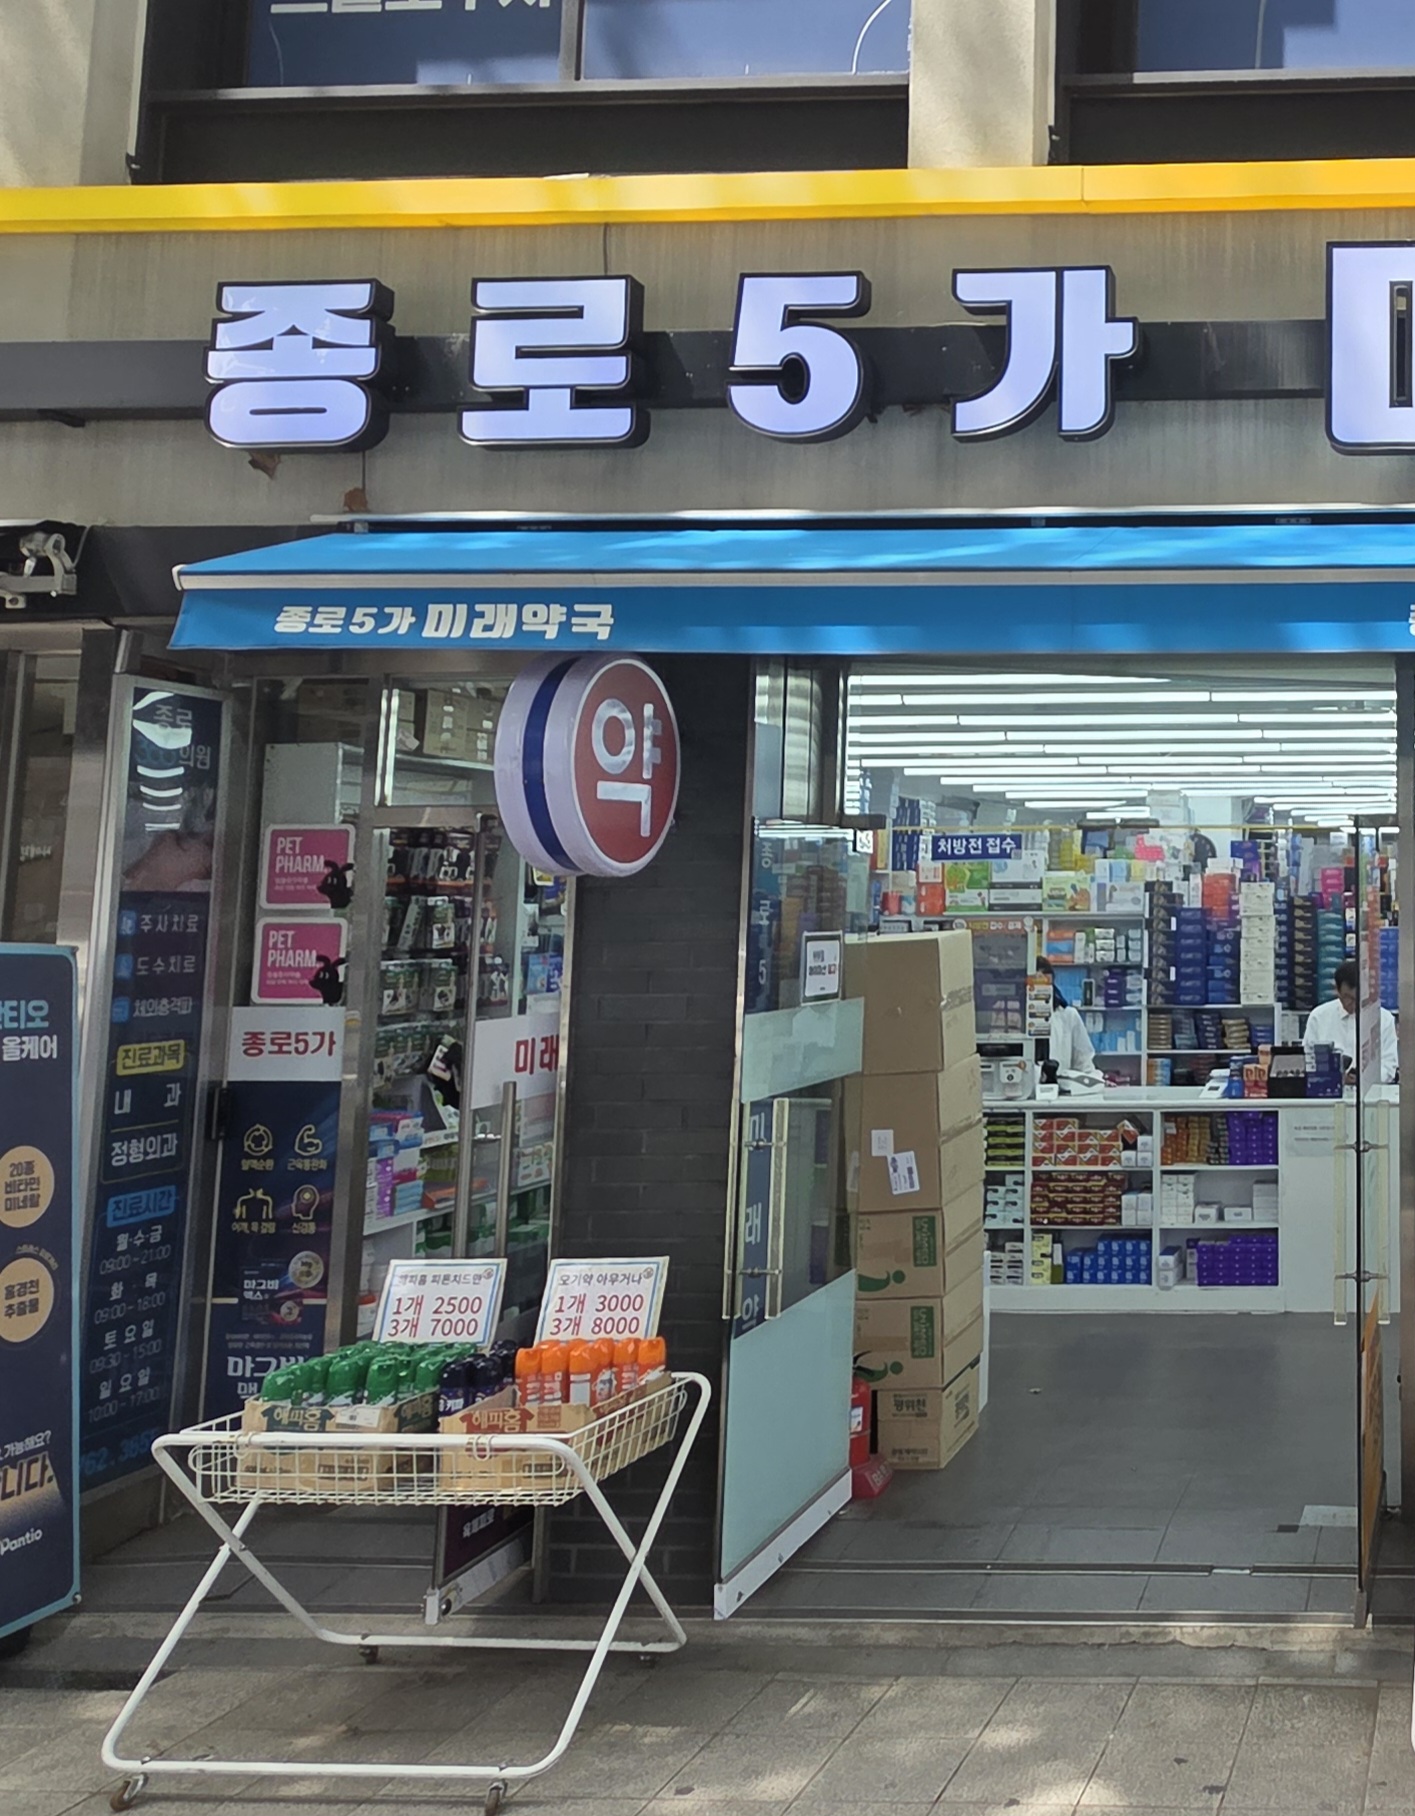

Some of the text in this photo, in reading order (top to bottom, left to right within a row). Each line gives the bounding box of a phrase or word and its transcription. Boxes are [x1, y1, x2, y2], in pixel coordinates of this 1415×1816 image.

[203, 266, 1140, 448] 종로5가
[274, 603, 615, 640] 종로5가 미래약국
[591, 698, 661, 838] 약
[276, 836, 303, 854] PET
[937, 836, 1017, 855] 처방전 접수
[140, 914, 199, 933] 주사치료
[268, 930, 294, 949] PET
[136, 955, 196, 976] 도수치료
[0, 1000, 49, 1029] 티오
[2, 1034, 58, 1062] 올케어
[241, 1030, 337, 1057] 종로5가
[121, 1046, 182, 1070] 진료과목
[110, 1134, 179, 1166] 정형외과
[112, 1190, 174, 1222] 진료시간
[243, 1279, 280, 1290] 마그비
[391, 1294, 483, 1316] 1개 2500
[554, 1293, 645, 1315] 1개 3000
[387, 1316, 479, 1338] 3개 7000
[549, 1315, 641, 1337] 3개 8000
[272, 1407, 323, 1432] 해피홈
[471, 1408, 521, 1433] 해피홈
[0, 1454, 55, 1501] 니다.
[0, 1527, 43, 1555] Pantio
